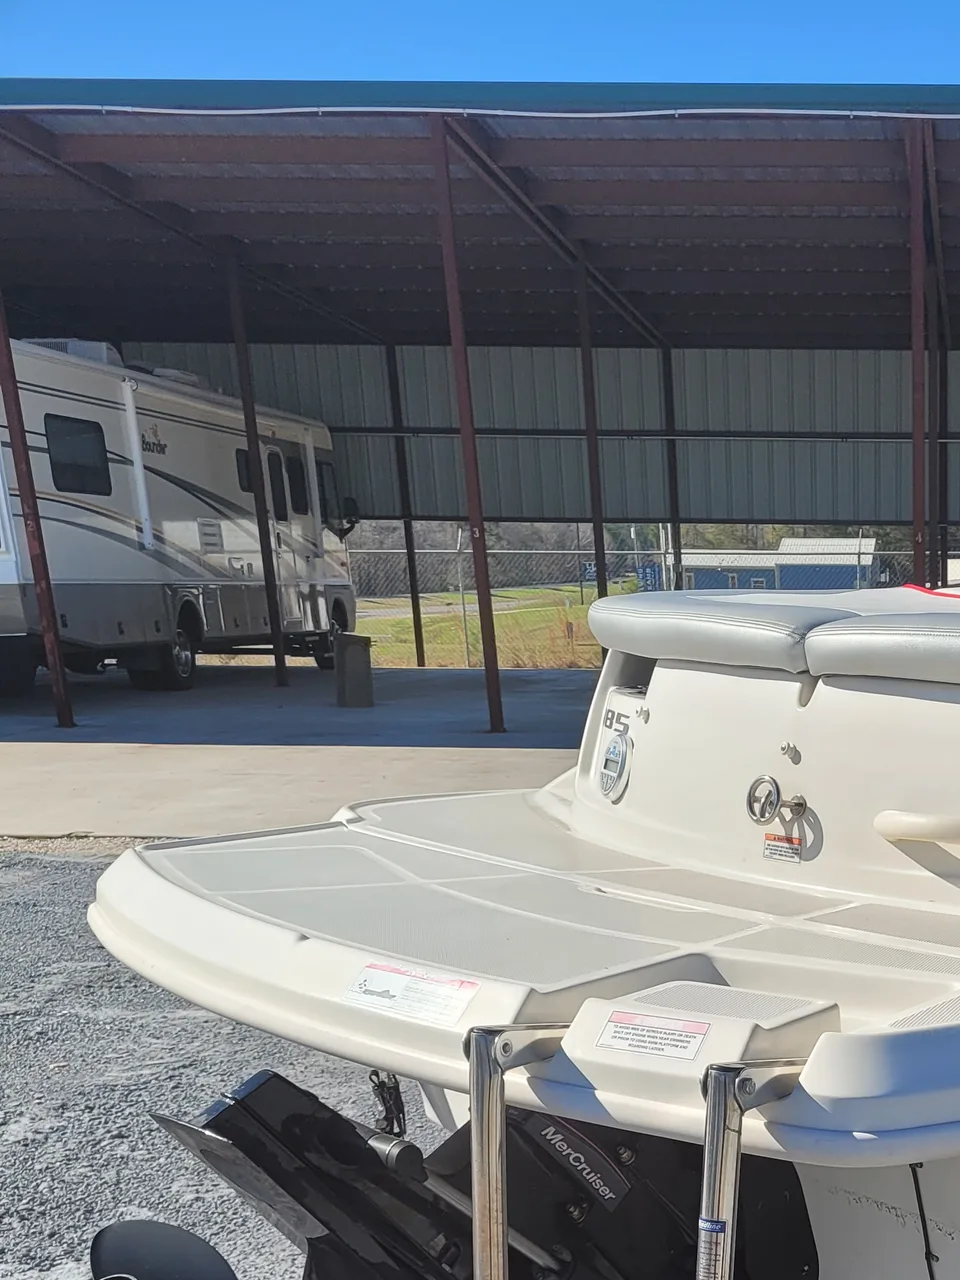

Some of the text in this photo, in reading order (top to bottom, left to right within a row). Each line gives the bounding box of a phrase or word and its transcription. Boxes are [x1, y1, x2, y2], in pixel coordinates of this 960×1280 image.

[26, 520, 35, 531] 2
[473, 528, 480, 538] 3
[540, 1126, 617, 1201] MerCruiser
